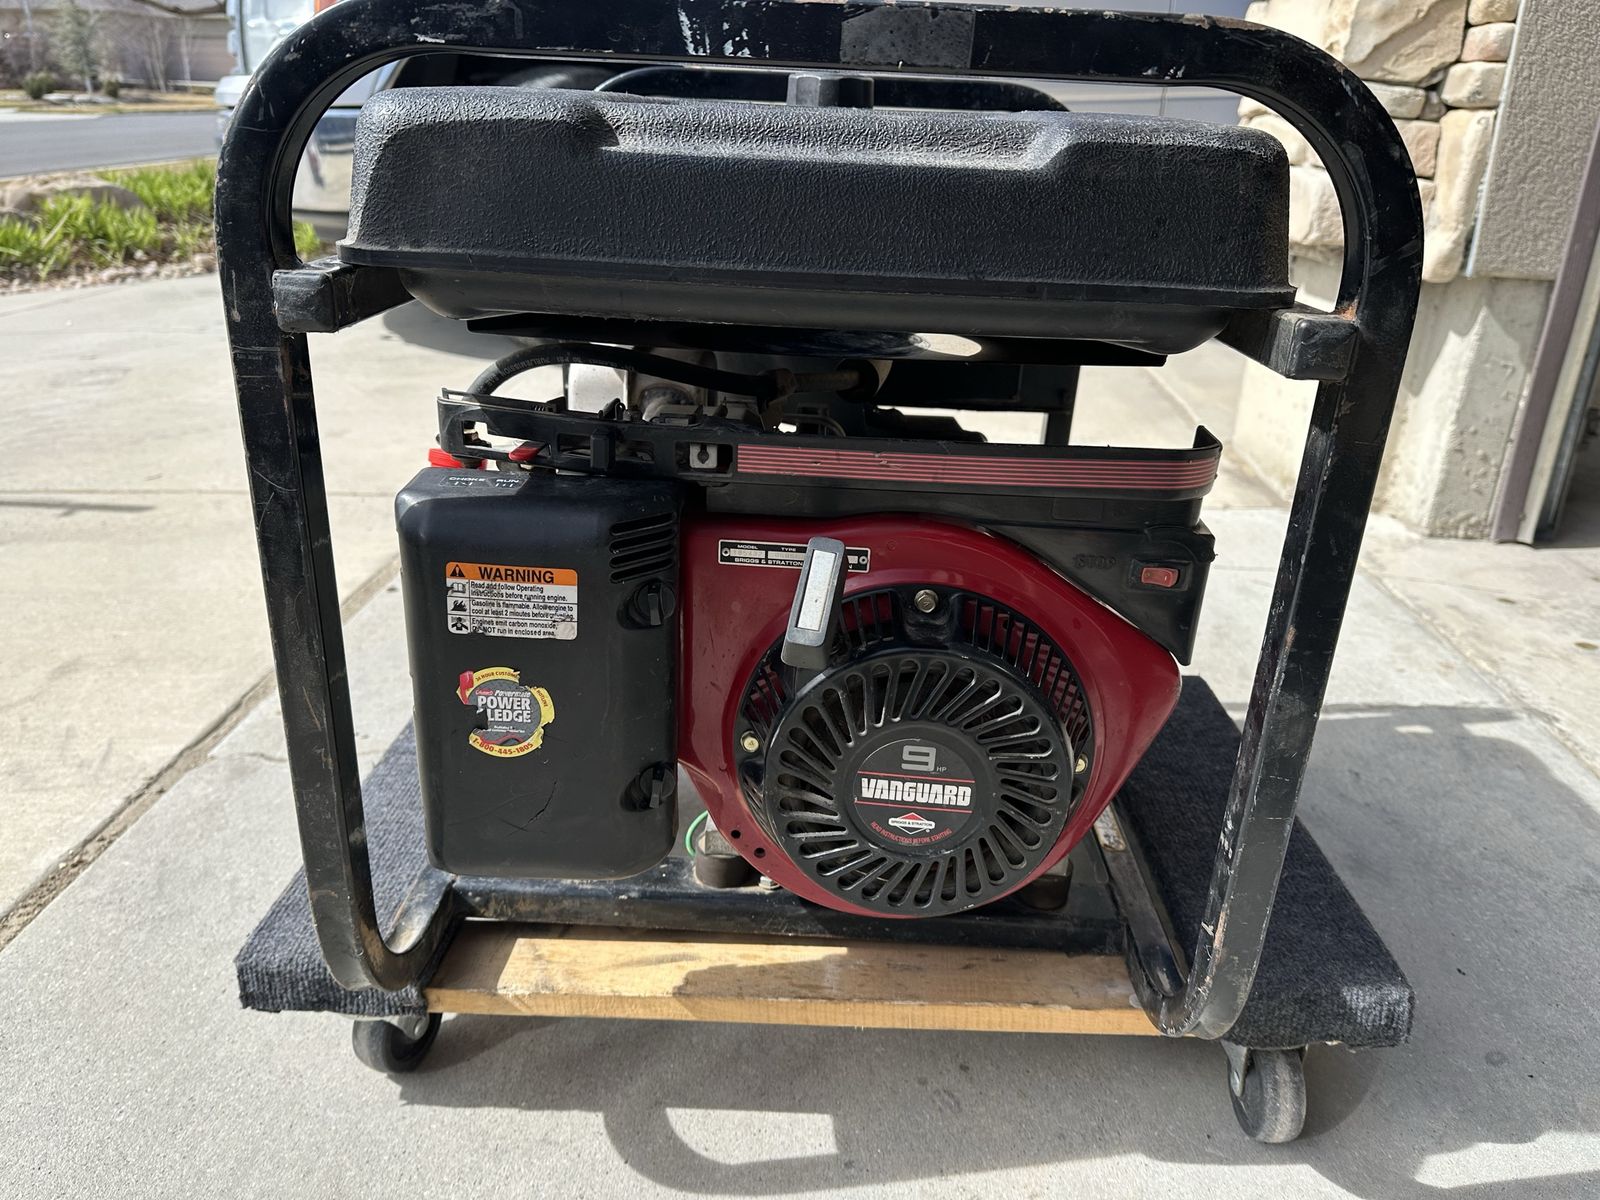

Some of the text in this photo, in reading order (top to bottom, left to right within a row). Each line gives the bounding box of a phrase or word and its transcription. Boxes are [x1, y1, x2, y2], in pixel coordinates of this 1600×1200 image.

[478, 566, 554, 584] WARNING
[470, 581, 544, 594] Read and follow Operating
[471, 599, 496, 607] Gasoline
[496, 600, 501, 608] is
[524, 594, 546, 602] running
[547, 595, 568, 603] engine.
[531, 611, 549, 619] before
[471, 618, 494, 626] Engines
[529, 622, 558, 630] monoxide,
[477, 695, 531, 710] POWER
[472, 737, 534, 755] 1-800-445-1805
[901, 745, 937, 772] 9
[861, 777, 972, 807] VANGUARD
